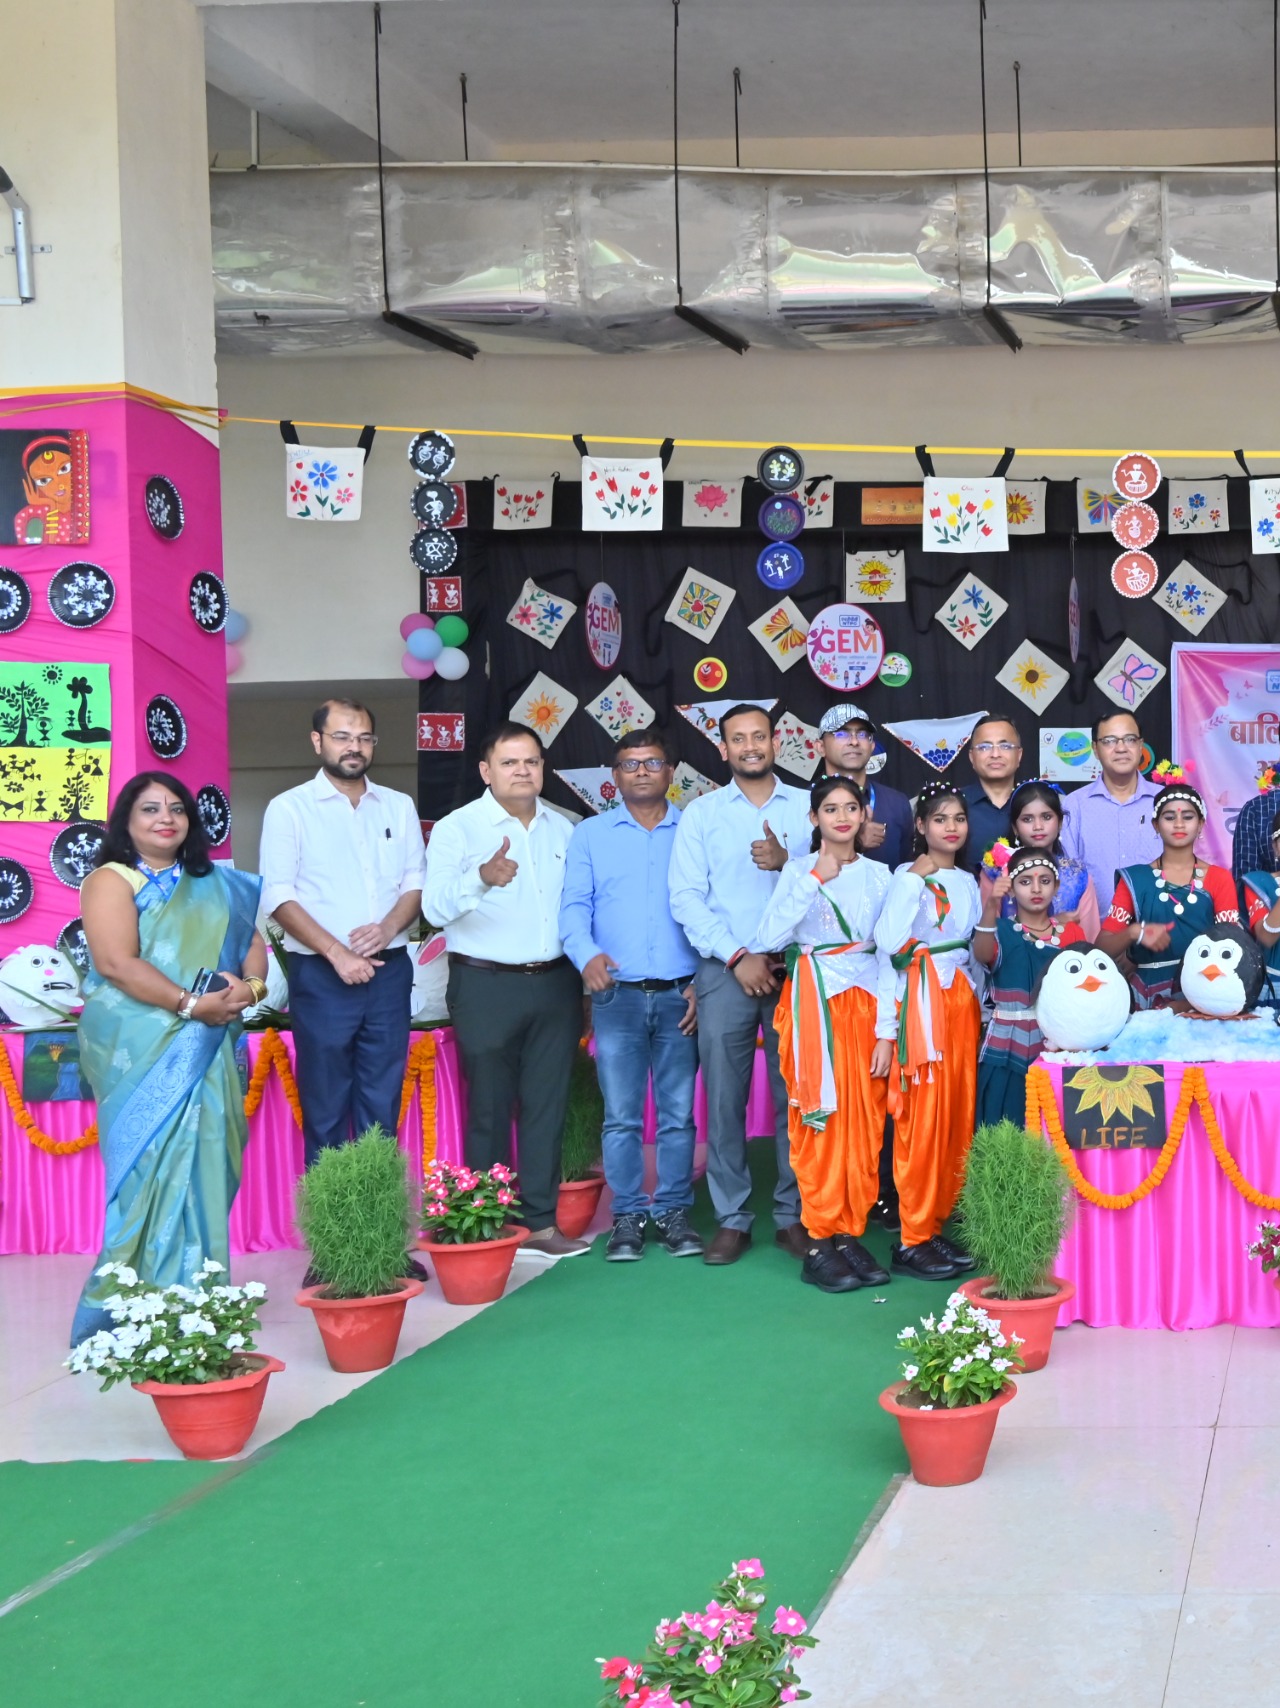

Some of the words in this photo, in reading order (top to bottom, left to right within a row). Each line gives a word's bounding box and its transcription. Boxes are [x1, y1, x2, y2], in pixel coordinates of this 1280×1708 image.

[591, 604, 620, 635] GEM
[818, 627, 877, 654] GEM
[1228, 711, 1280, 745] बालि
[1080, 1126, 1148, 1150] LIFE
